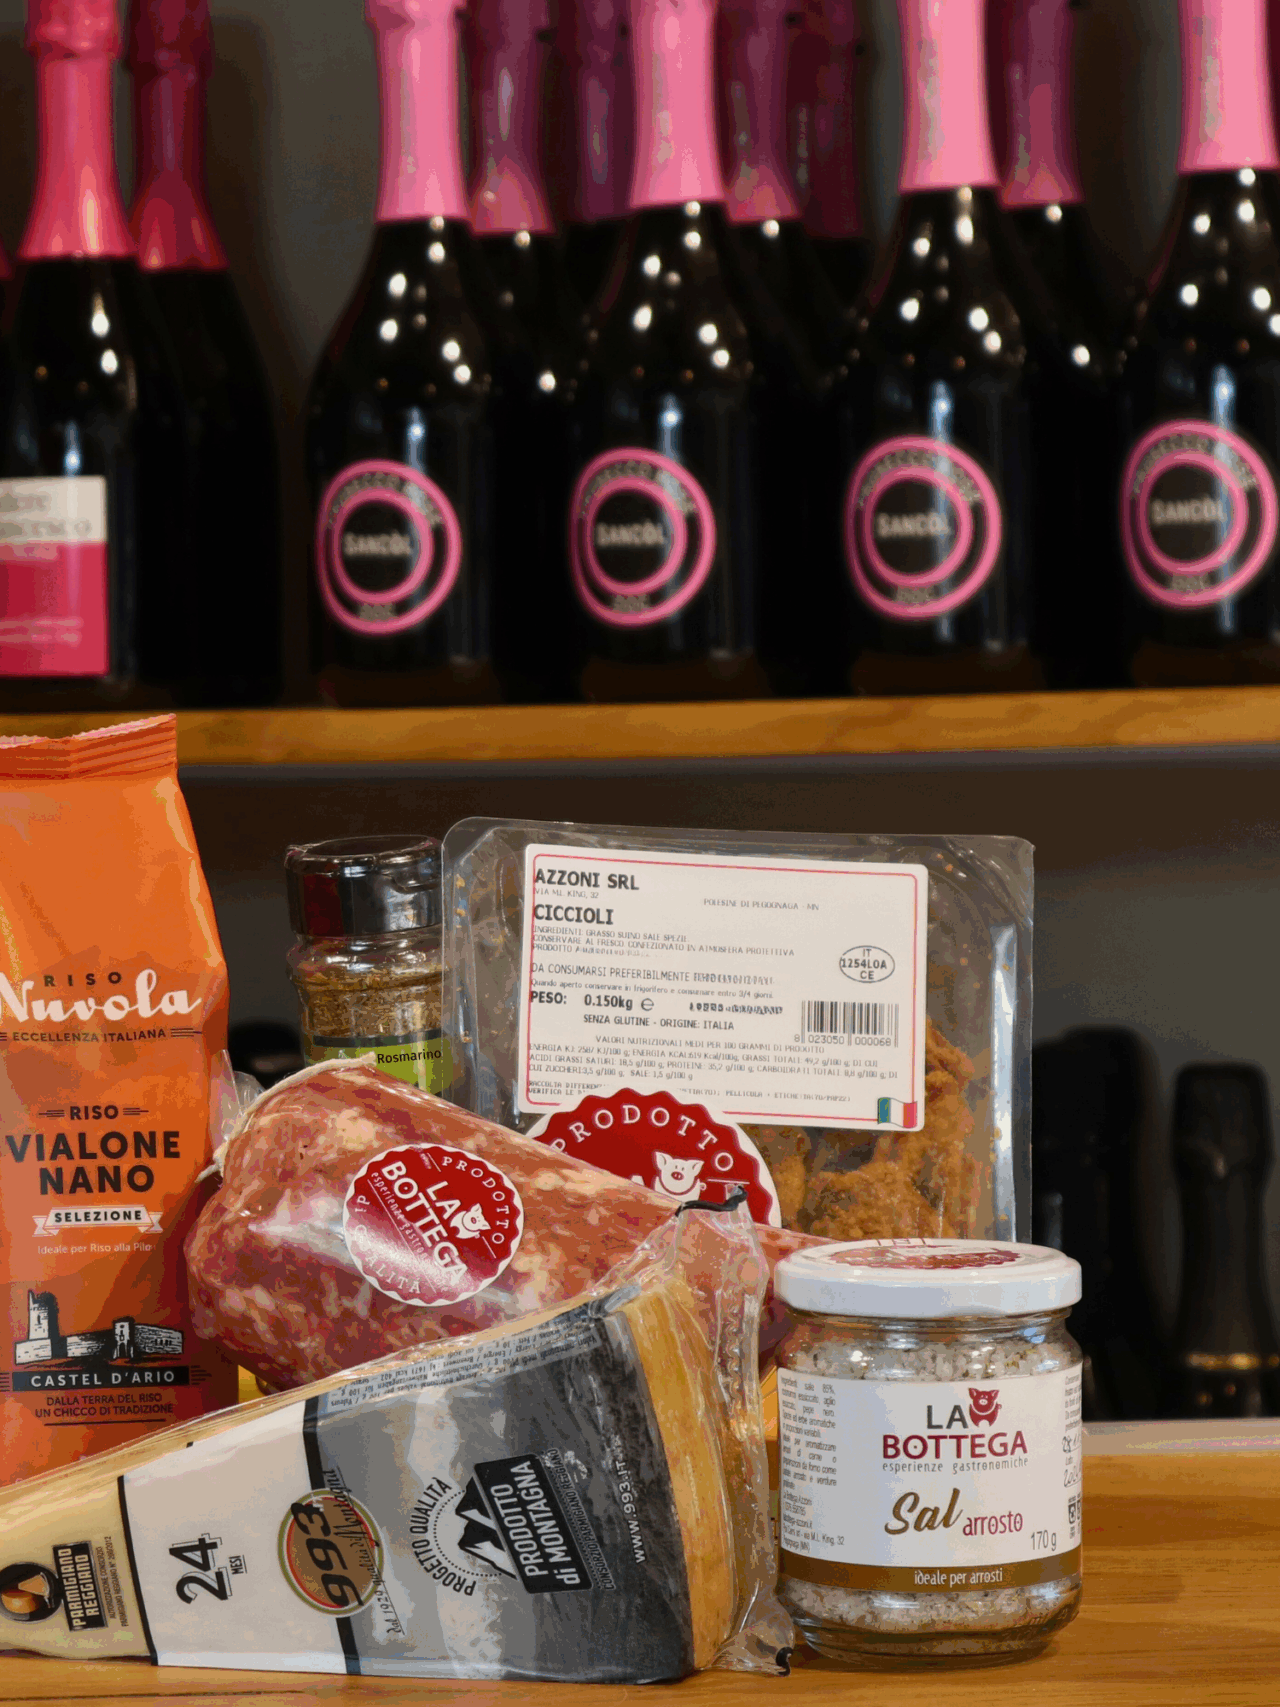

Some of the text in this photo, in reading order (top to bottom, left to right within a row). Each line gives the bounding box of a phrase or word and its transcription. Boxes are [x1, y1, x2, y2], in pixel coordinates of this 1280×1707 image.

[534, 868, 641, 890] AZZONI SRL
[533, 903, 614, 925] CICCIOLI
[532, 942, 572, 952] PRODOTTO
[44, 971, 122, 987] RISO
[531, 962, 545, 972] DA
[547, 963, 607, 976] CONSUMARSI
[611, 967, 692, 981] PREFERIBILMENTE
[860, 971, 874, 980] CE
[530, 990, 633, 1011] PESO: 0.150kg
[583, 1013, 734, 1030] SENZA GLUTINE ORIGINE: ITALIA
[13, 1029, 166, 1043] ECCELLENZA ITALIANA
[377, 1049, 441, 1063] Rosmarino
[70, 1105, 119, 1120] RISO
[6, 1131, 180, 1163] VIALONE
[549, 1104, 734, 1171] PRODOTTO
[40, 1165, 154, 1195] NANO
[354, 1195, 370, 1213] di
[426, 1181, 461, 1219] LA
[442, 1156, 509, 1244] PRODOTTO
[54, 1210, 142, 1223] SELEZIONE
[381, 1161, 468, 1286] BOTTEGA
[38, 1242, 131, 1255] Ideale per Riso alla
[31, 1371, 175, 1388] CASTEL D'ARIO
[47, 1393, 162, 1406] DALLA TERRA DEL RISO
[35, 1404, 173, 1418] UN CHICCO DI TRADIZIONE
[927, 1405, 969, 1429] LA
[883, 1431, 1028, 1459] BOTTEGA
[883, 1456, 1028, 1475] esperienze gastronomiche
[547, 1447, 615, 1591] CONSORZIO PARMIGIANO REGGIANO
[884, 1488, 1023, 1536] Sal arrosto
[490, 1483, 549, 1577] PRODOTTO
[510, 1461, 581, 1585] di MONTAGNA
[1031, 1530, 1057, 1551] 170 g
[291, 1502, 365, 1607] 993
[169, 1536, 228, 1604] 24
[229, 1556, 244, 1575] MESI
[411, 1538, 477, 1597] PROGETTO
[57, 1547, 86, 1627] PARMIGIANO
[74, 1553, 99, 1616] REGGIANO
[914, 1568, 1003, 1588] ideale per arrosti
